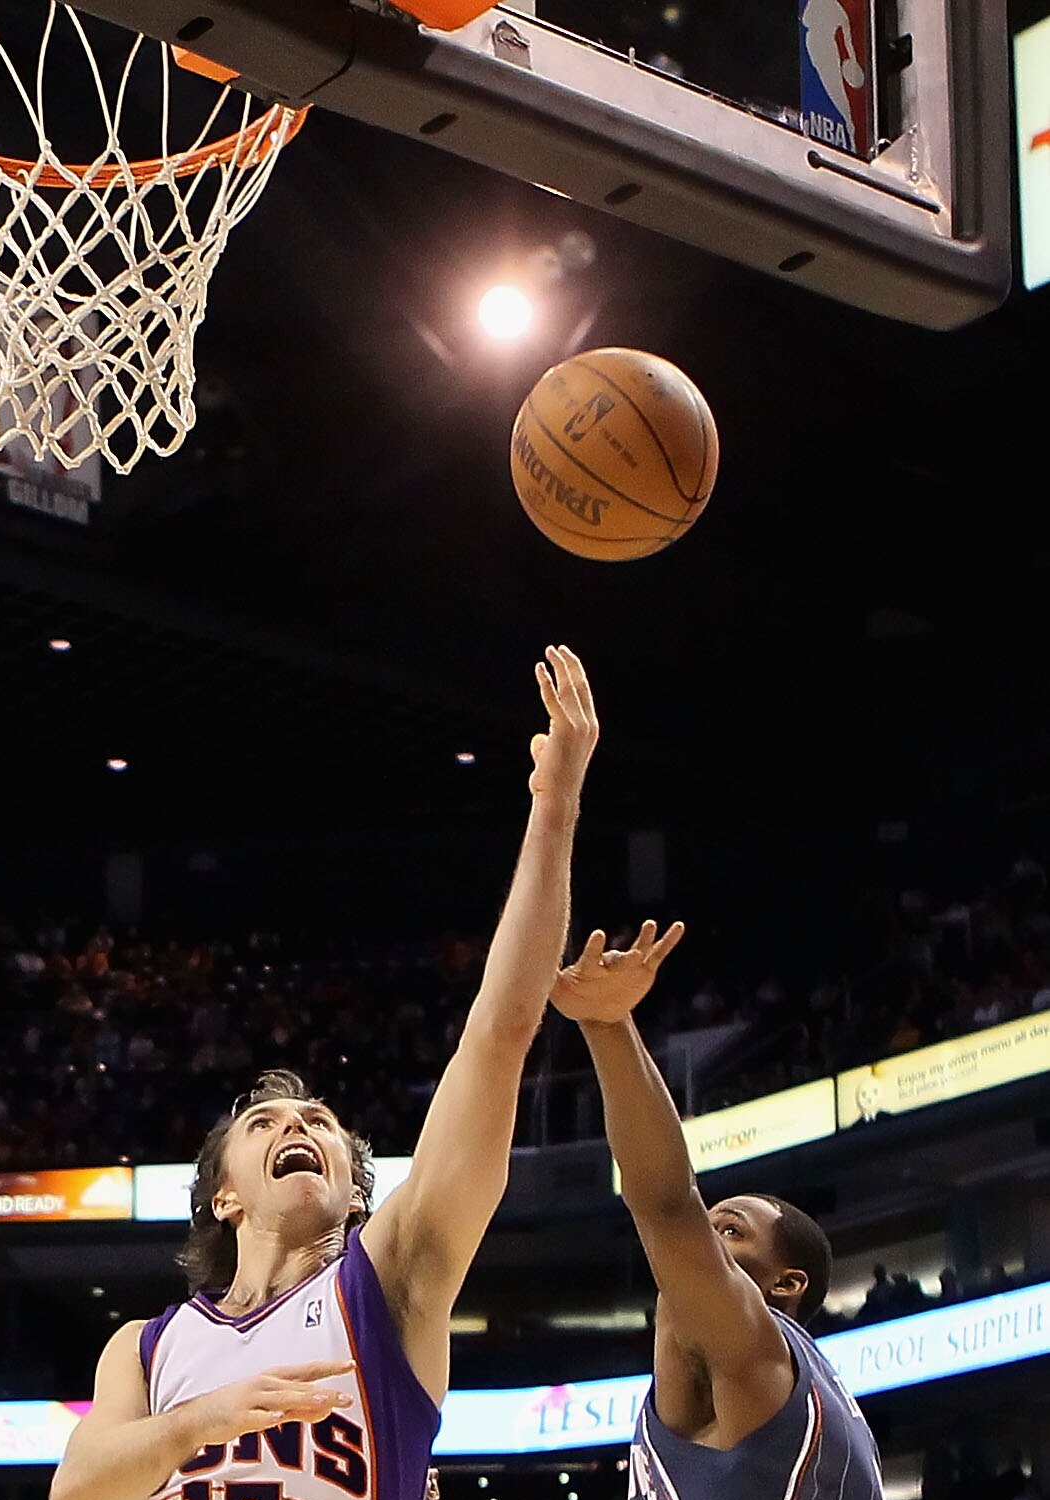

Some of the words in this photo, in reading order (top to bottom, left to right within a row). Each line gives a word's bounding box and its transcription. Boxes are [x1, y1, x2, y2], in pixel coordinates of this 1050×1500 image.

[810, 112, 847, 148] NBA
[515, 420, 610, 527] SPALDIN
[897, 1069, 926, 1086] Enjoy
[700, 1126, 757, 1154] verizon
[15, 1194, 65, 1213] READY
[860, 1335, 924, 1375] POOL
[948, 1303, 1046, 1359] SUPPLIE
[539, 1394, 638, 1434] LESLI
